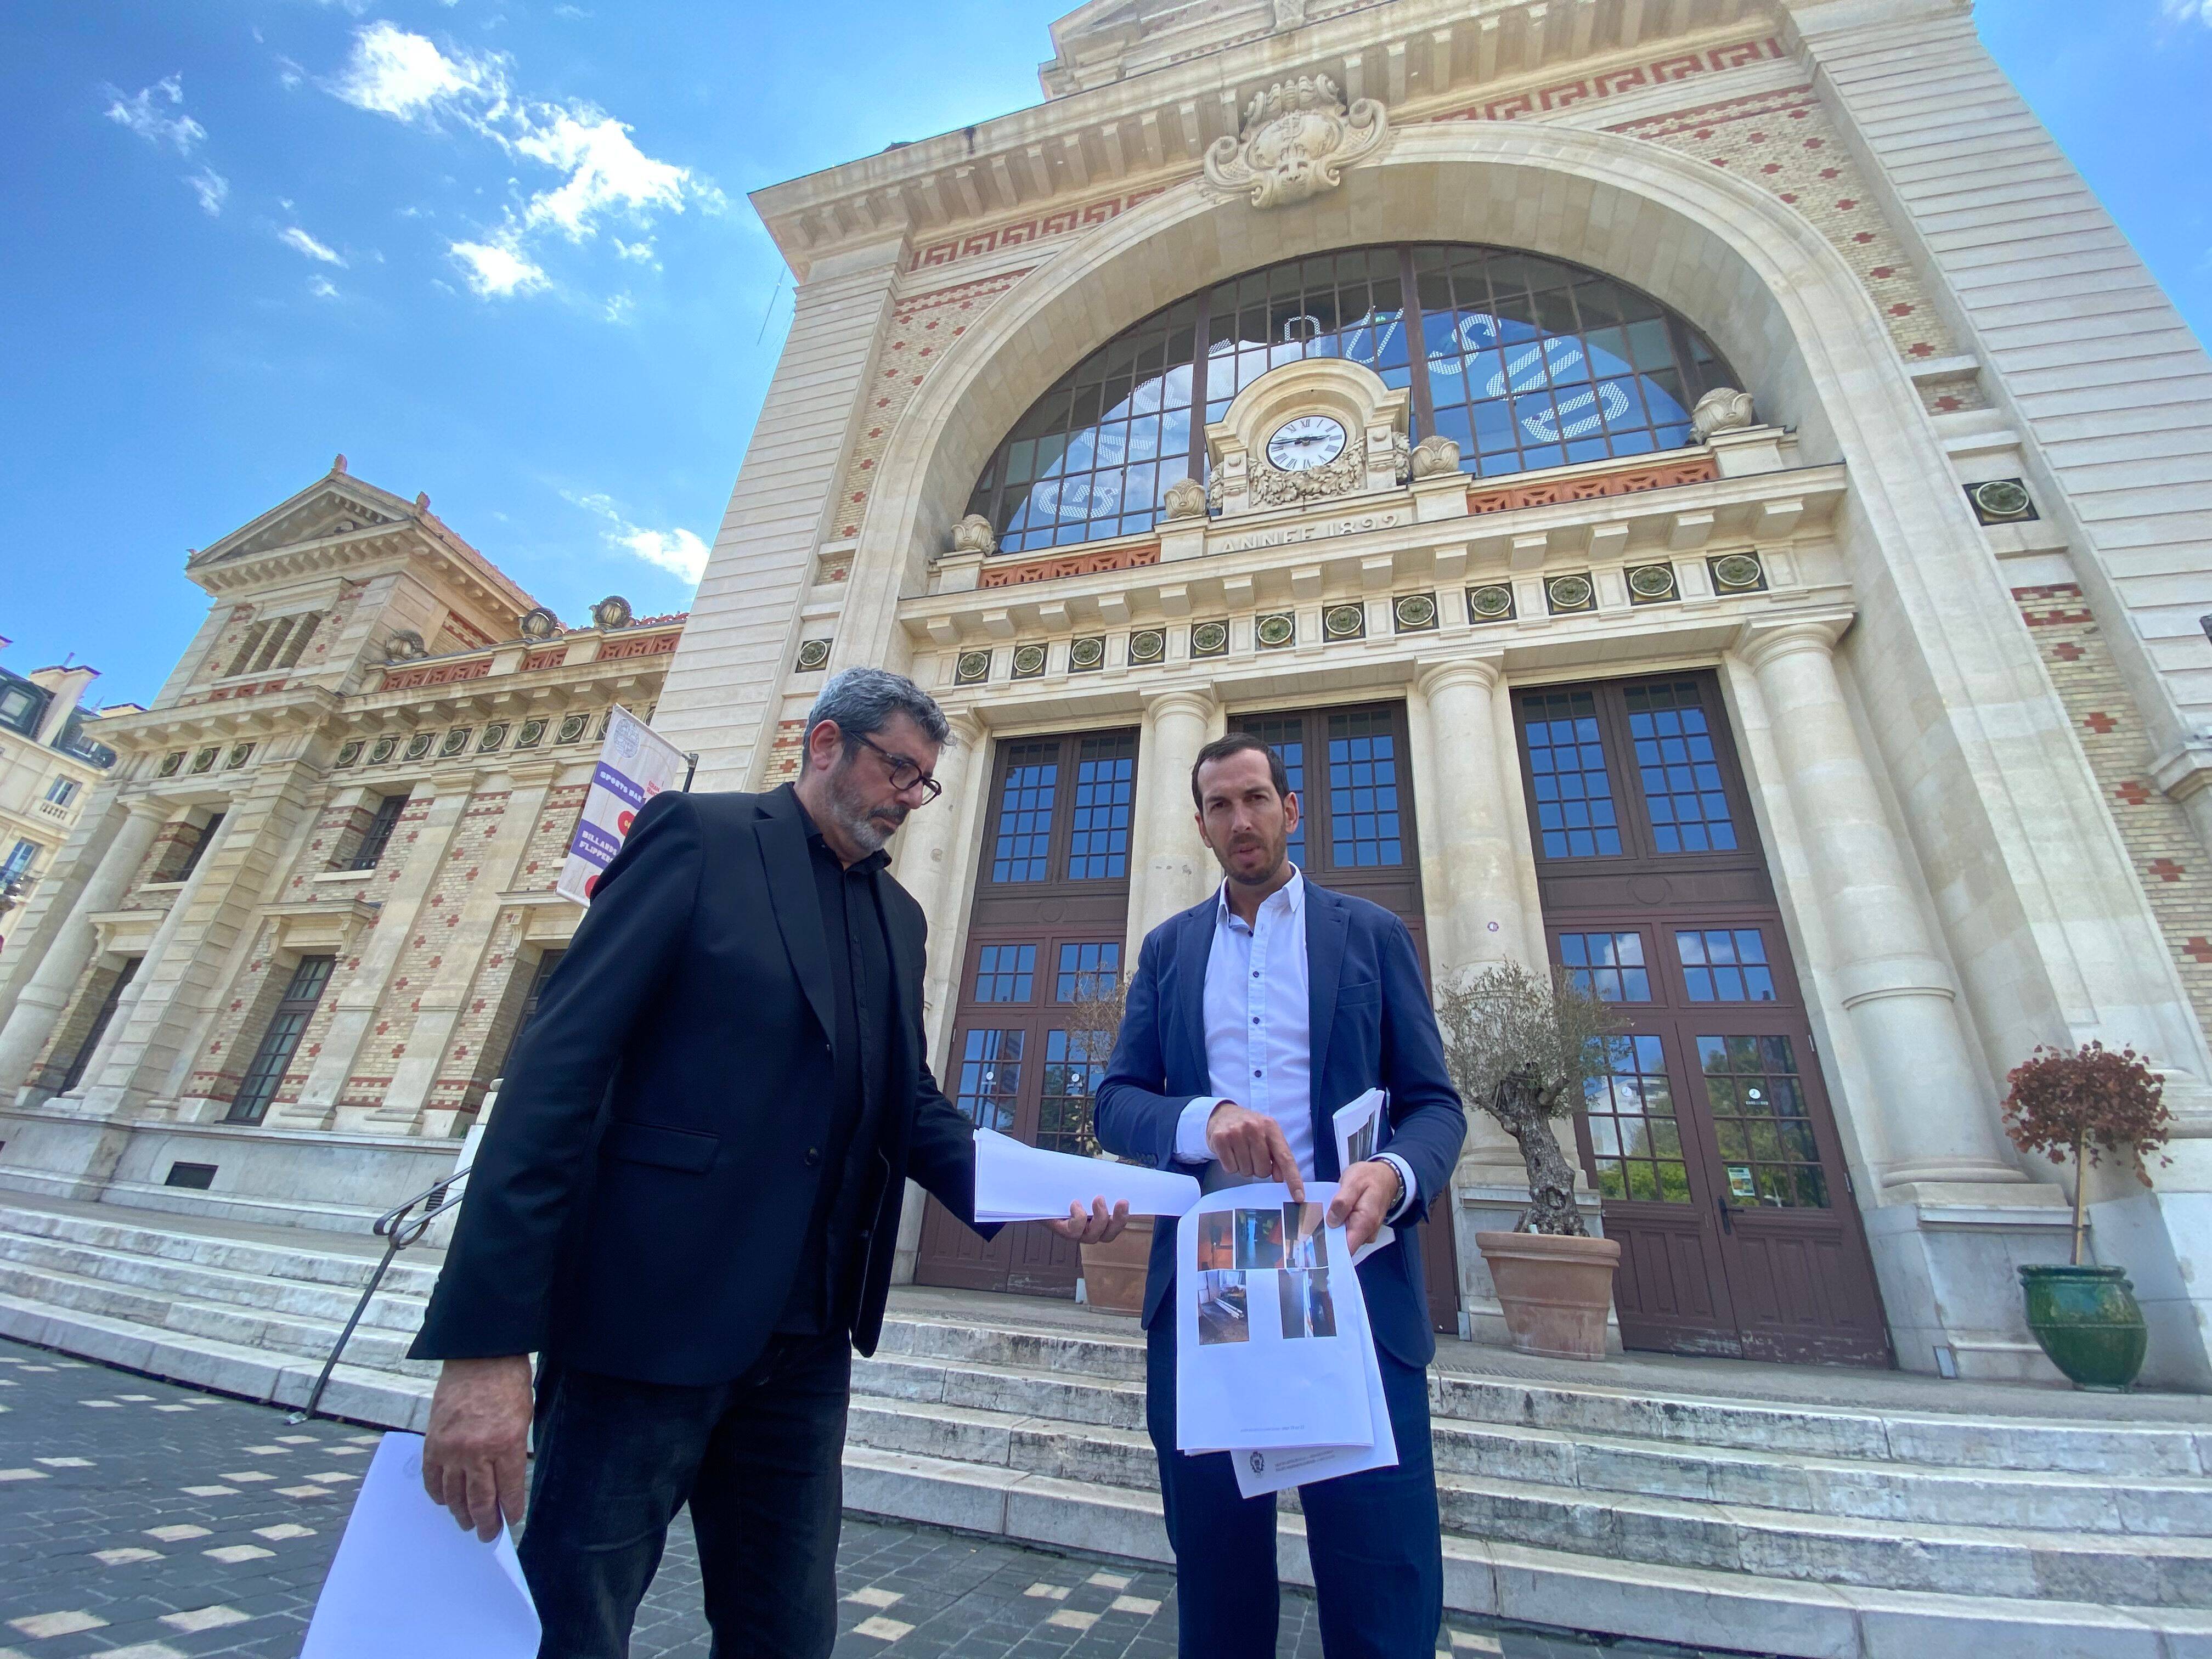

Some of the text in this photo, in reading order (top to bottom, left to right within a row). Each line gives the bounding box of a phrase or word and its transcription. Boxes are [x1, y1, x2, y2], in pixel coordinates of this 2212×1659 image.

[1428, 313, 1629, 442] SUD
[1300, 419, 1311, 428] XII
[600, 771, 642, 803] SPORTS BAR
[582, 830, 617, 856] BILLARDS
